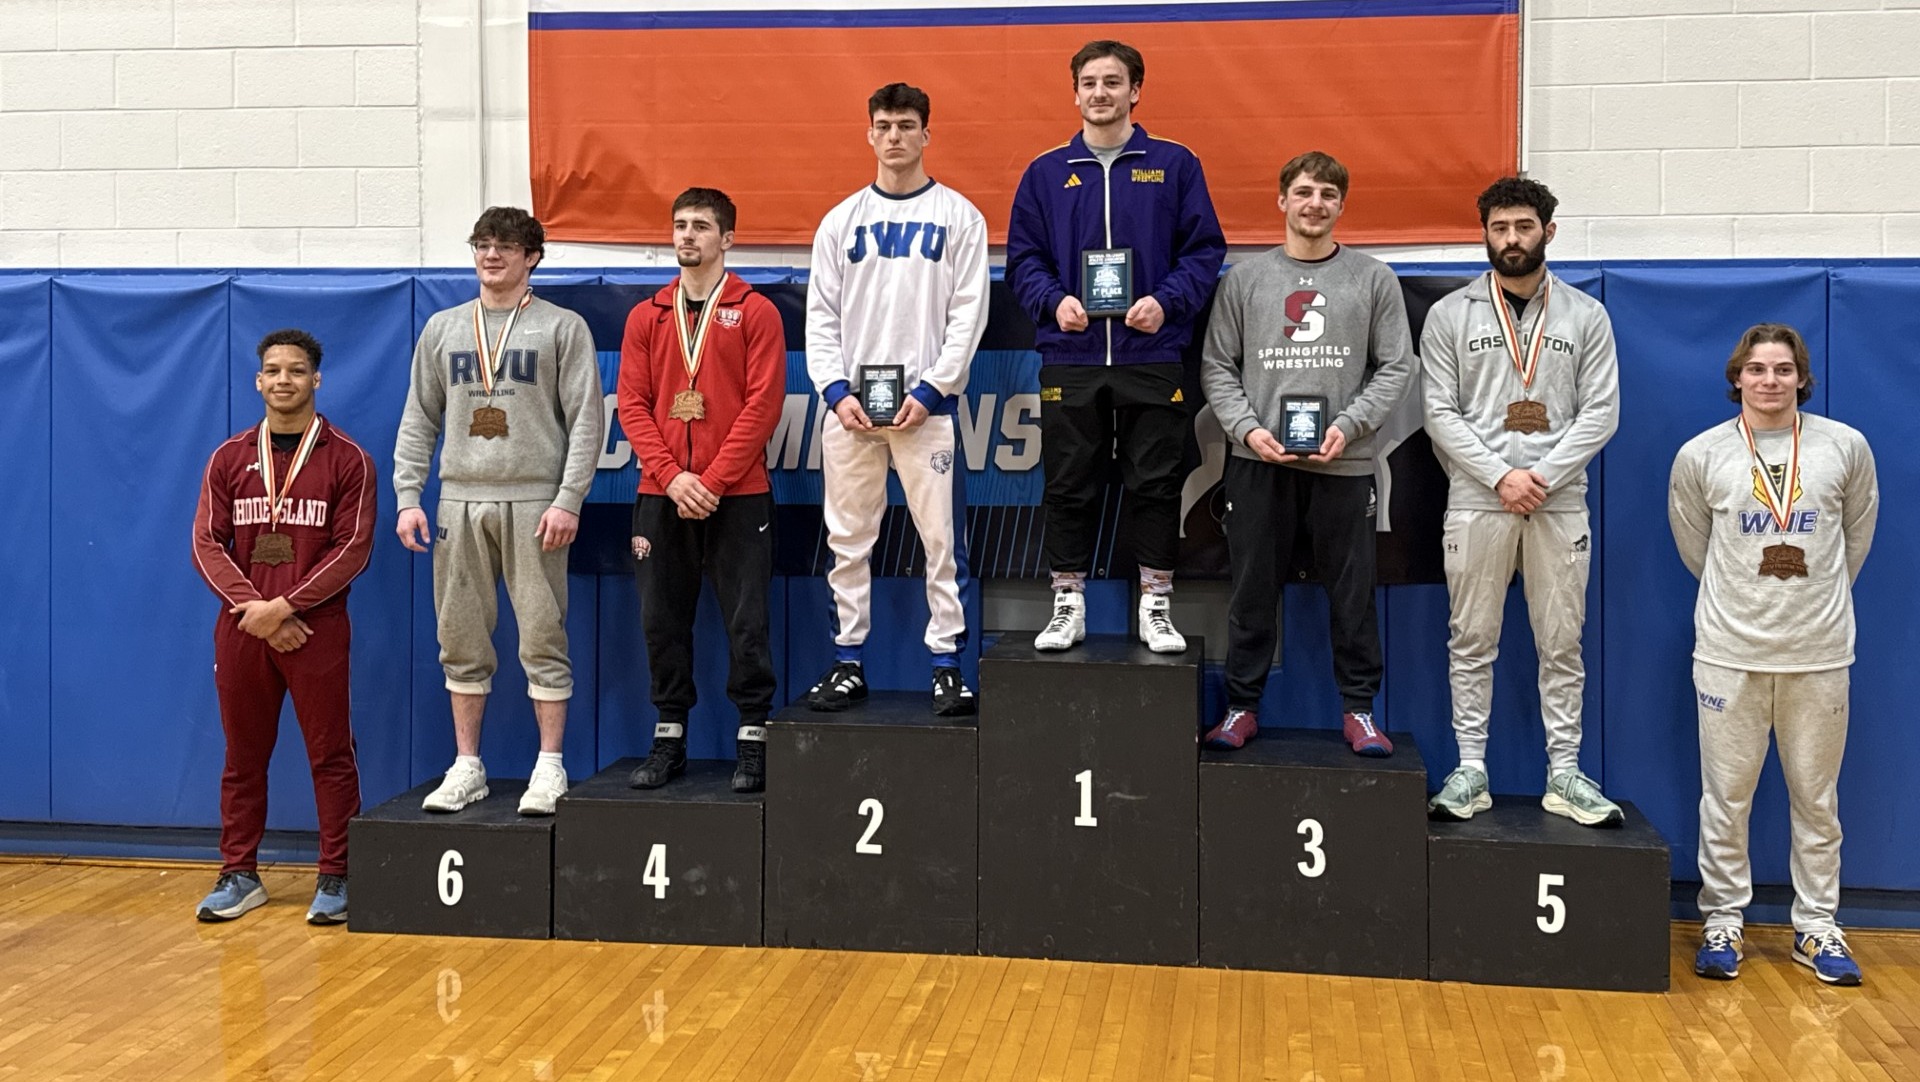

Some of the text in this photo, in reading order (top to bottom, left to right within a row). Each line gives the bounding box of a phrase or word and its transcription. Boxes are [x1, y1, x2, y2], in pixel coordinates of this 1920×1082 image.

[847, 221, 946, 264] JWU
[1284, 290, 1326, 342] S
[1258, 345, 1351, 359] SPRINGFIELD
[1263, 358, 1344, 370] WRESTLING
[1468, 333, 1574, 355] CASTON
[468, 389, 515, 398] WRETLING
[233, 497, 327, 527] HODE SLAND
[1738, 509, 1819, 536] WNE
[1699, 690, 1727, 709] WNE
[1075, 770, 1097, 826] 1
[856, 798, 883, 854] 2
[1297, 819, 1326, 877] 3
[438, 850, 463, 905] 6
[643, 844, 669, 899] 4
[1537, 874, 1565, 933] 5
